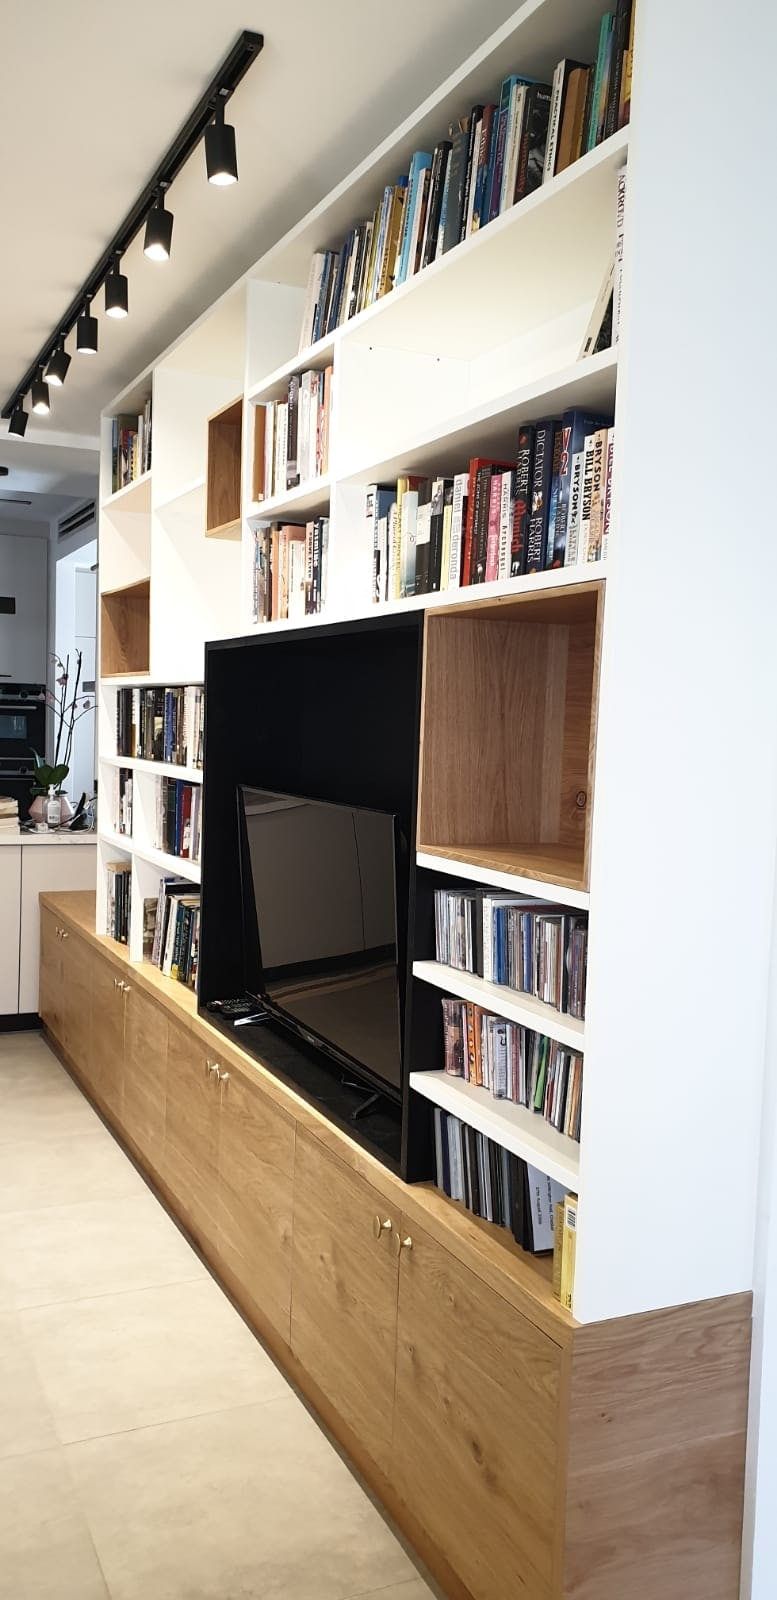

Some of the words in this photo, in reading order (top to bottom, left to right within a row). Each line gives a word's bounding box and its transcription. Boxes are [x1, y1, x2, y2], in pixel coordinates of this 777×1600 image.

[520, 449, 531, 495] ROBERT
[534, 429, 546, 488] DICTATOR
[584, 449, 594, 476] BILL
[593, 440, 602, 492] BRYSON
[454, 478, 463, 513] daniel
[572, 463, 581, 509] BRYSON
[581, 478, 592, 521] BRYSON
[511, 499, 527, 554] Munich
[527, 518, 536, 563] HARRIS
[533, 517, 543, 563] ROBERT
[450, 534, 460, 580] deronda
